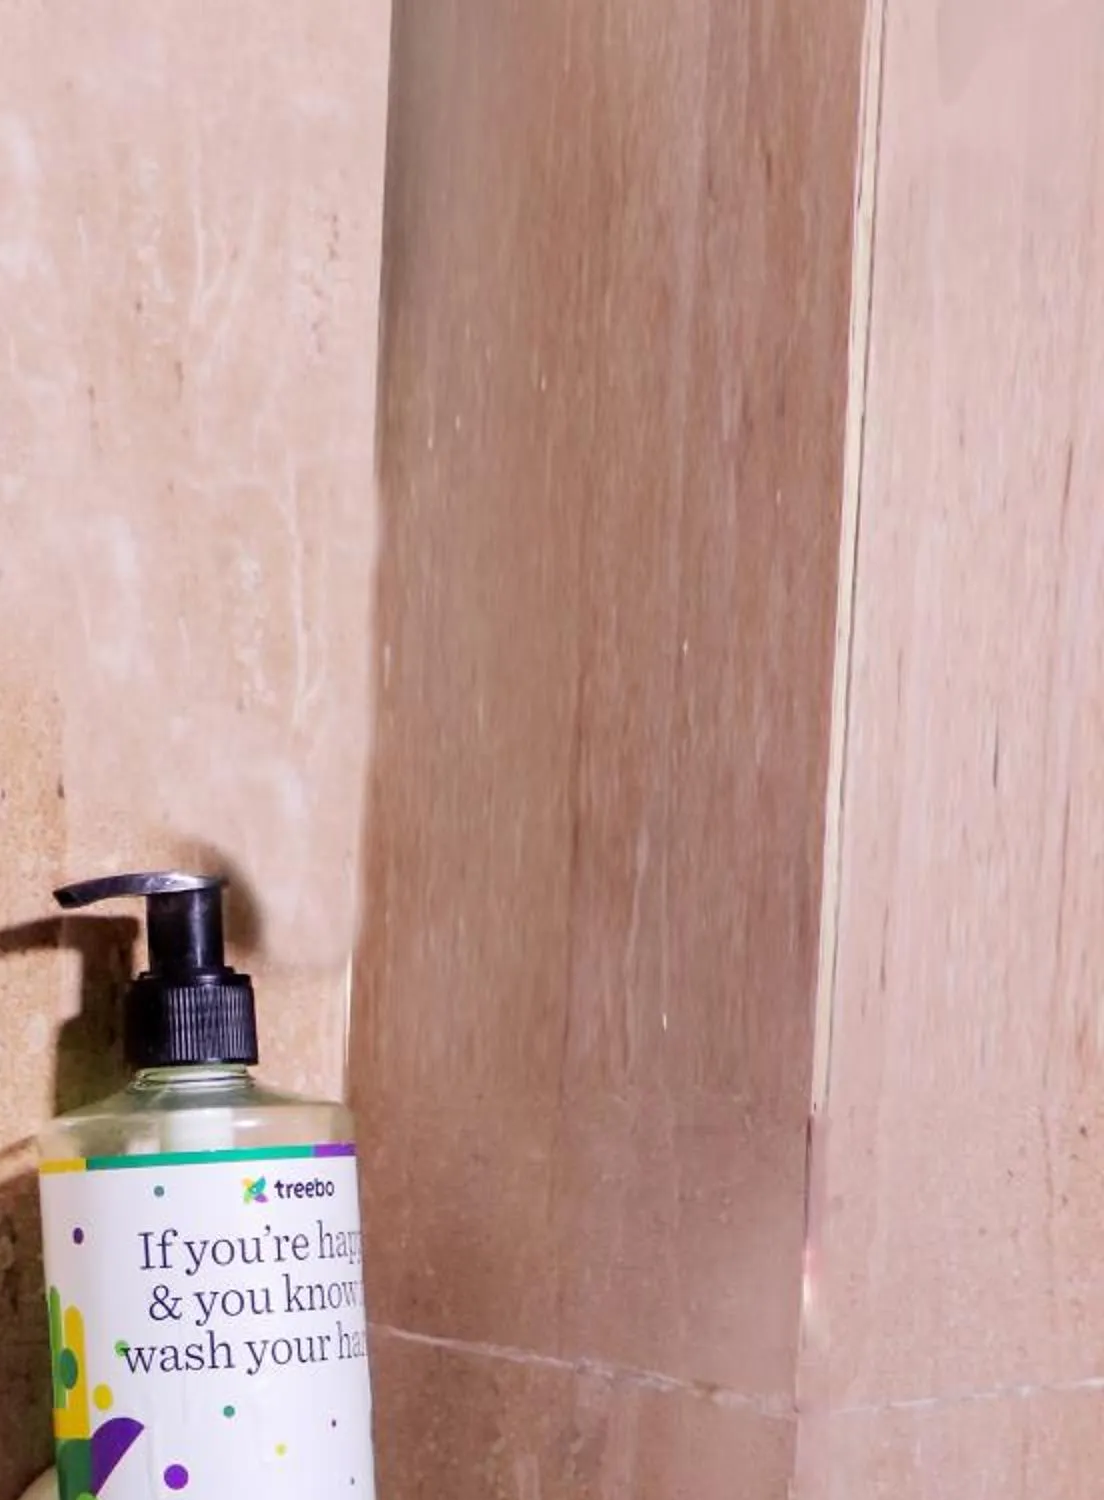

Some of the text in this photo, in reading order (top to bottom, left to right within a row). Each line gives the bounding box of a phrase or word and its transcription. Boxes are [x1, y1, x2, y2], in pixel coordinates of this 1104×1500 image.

[273, 1177, 335, 1200] treebo
[137, 1228, 178, 1270] If
[148, 1284, 183, 1321] &
[193, 1284, 274, 1327] you
[123, 1330, 236, 1374] wash
[244, 1336, 331, 1375] your
